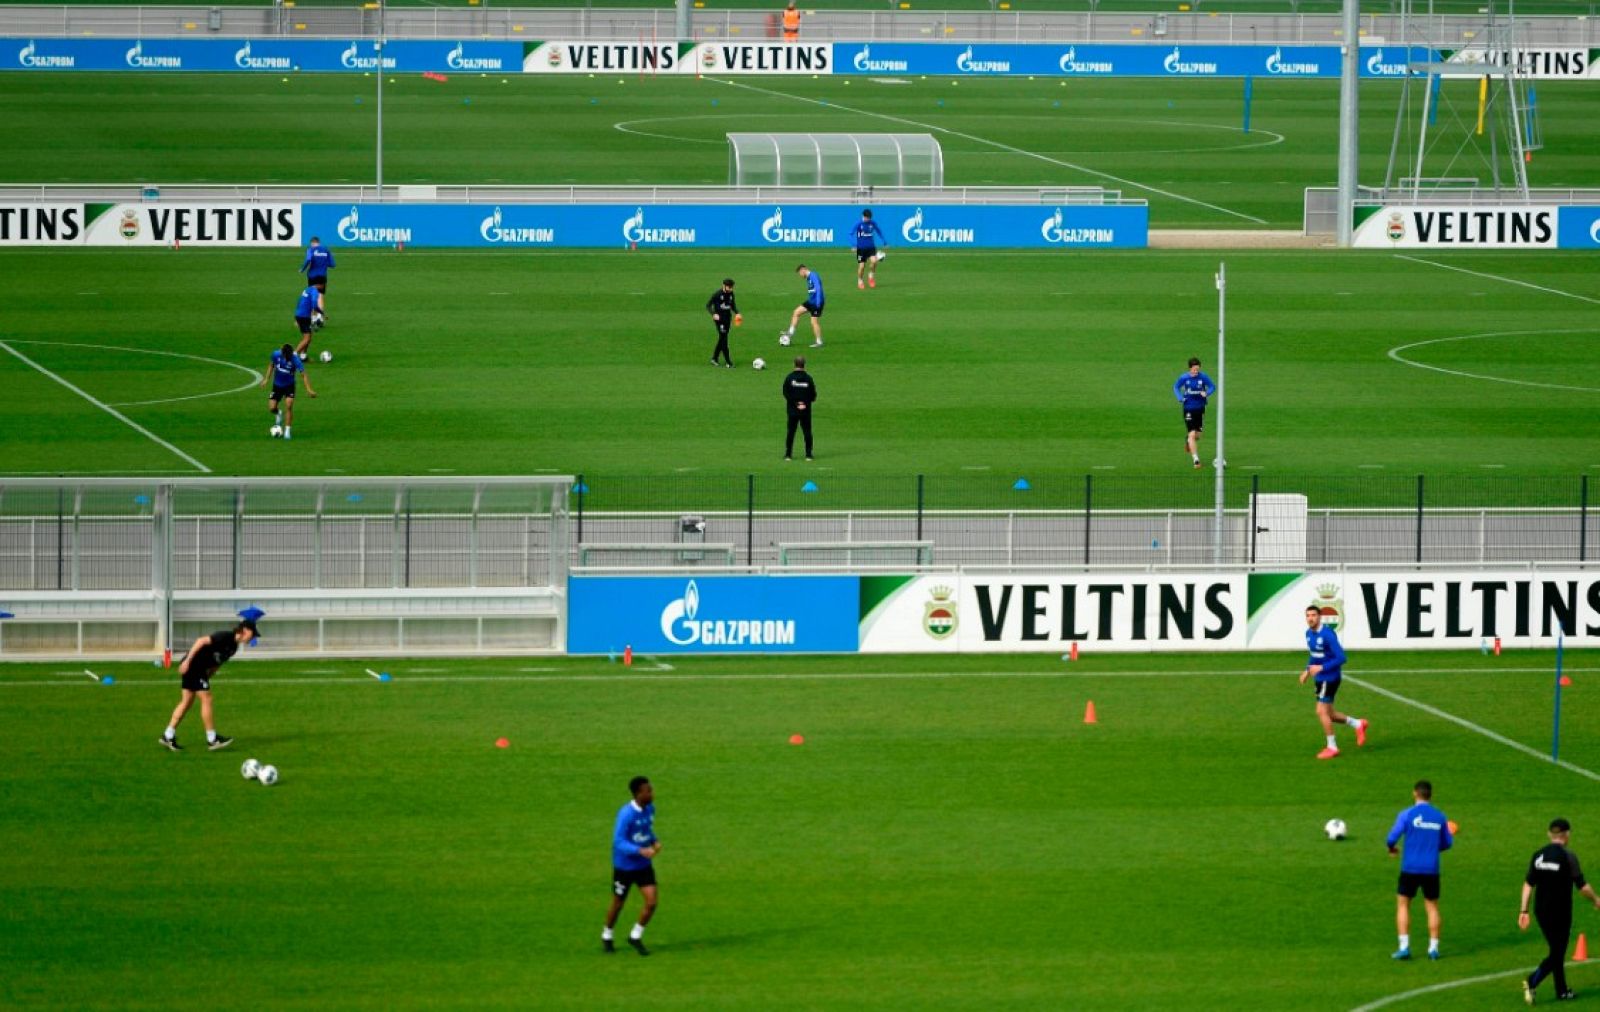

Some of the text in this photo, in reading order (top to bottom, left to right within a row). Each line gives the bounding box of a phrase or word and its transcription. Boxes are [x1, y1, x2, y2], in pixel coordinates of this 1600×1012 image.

[357, 57, 396, 68] GAZPOM
[569, 45, 673, 69] VELTINS
[723, 46, 827, 70] VELTINS
[148, 208, 295, 241] VELTINS
[1413, 211, 1552, 243] VELTINS
[360, 228, 412, 242] GAZPROM
[503, 228, 555, 242] GAZPROM
[644, 228, 696, 243] GAZPROM
[783, 228, 834, 243] GAZPROM
[923, 228, 974, 243] GAZPROM
[1063, 229, 1113, 243] GAZPROM
[974, 582, 1233, 641] VELTINS
[701, 620, 795, 645] GAZPROM
